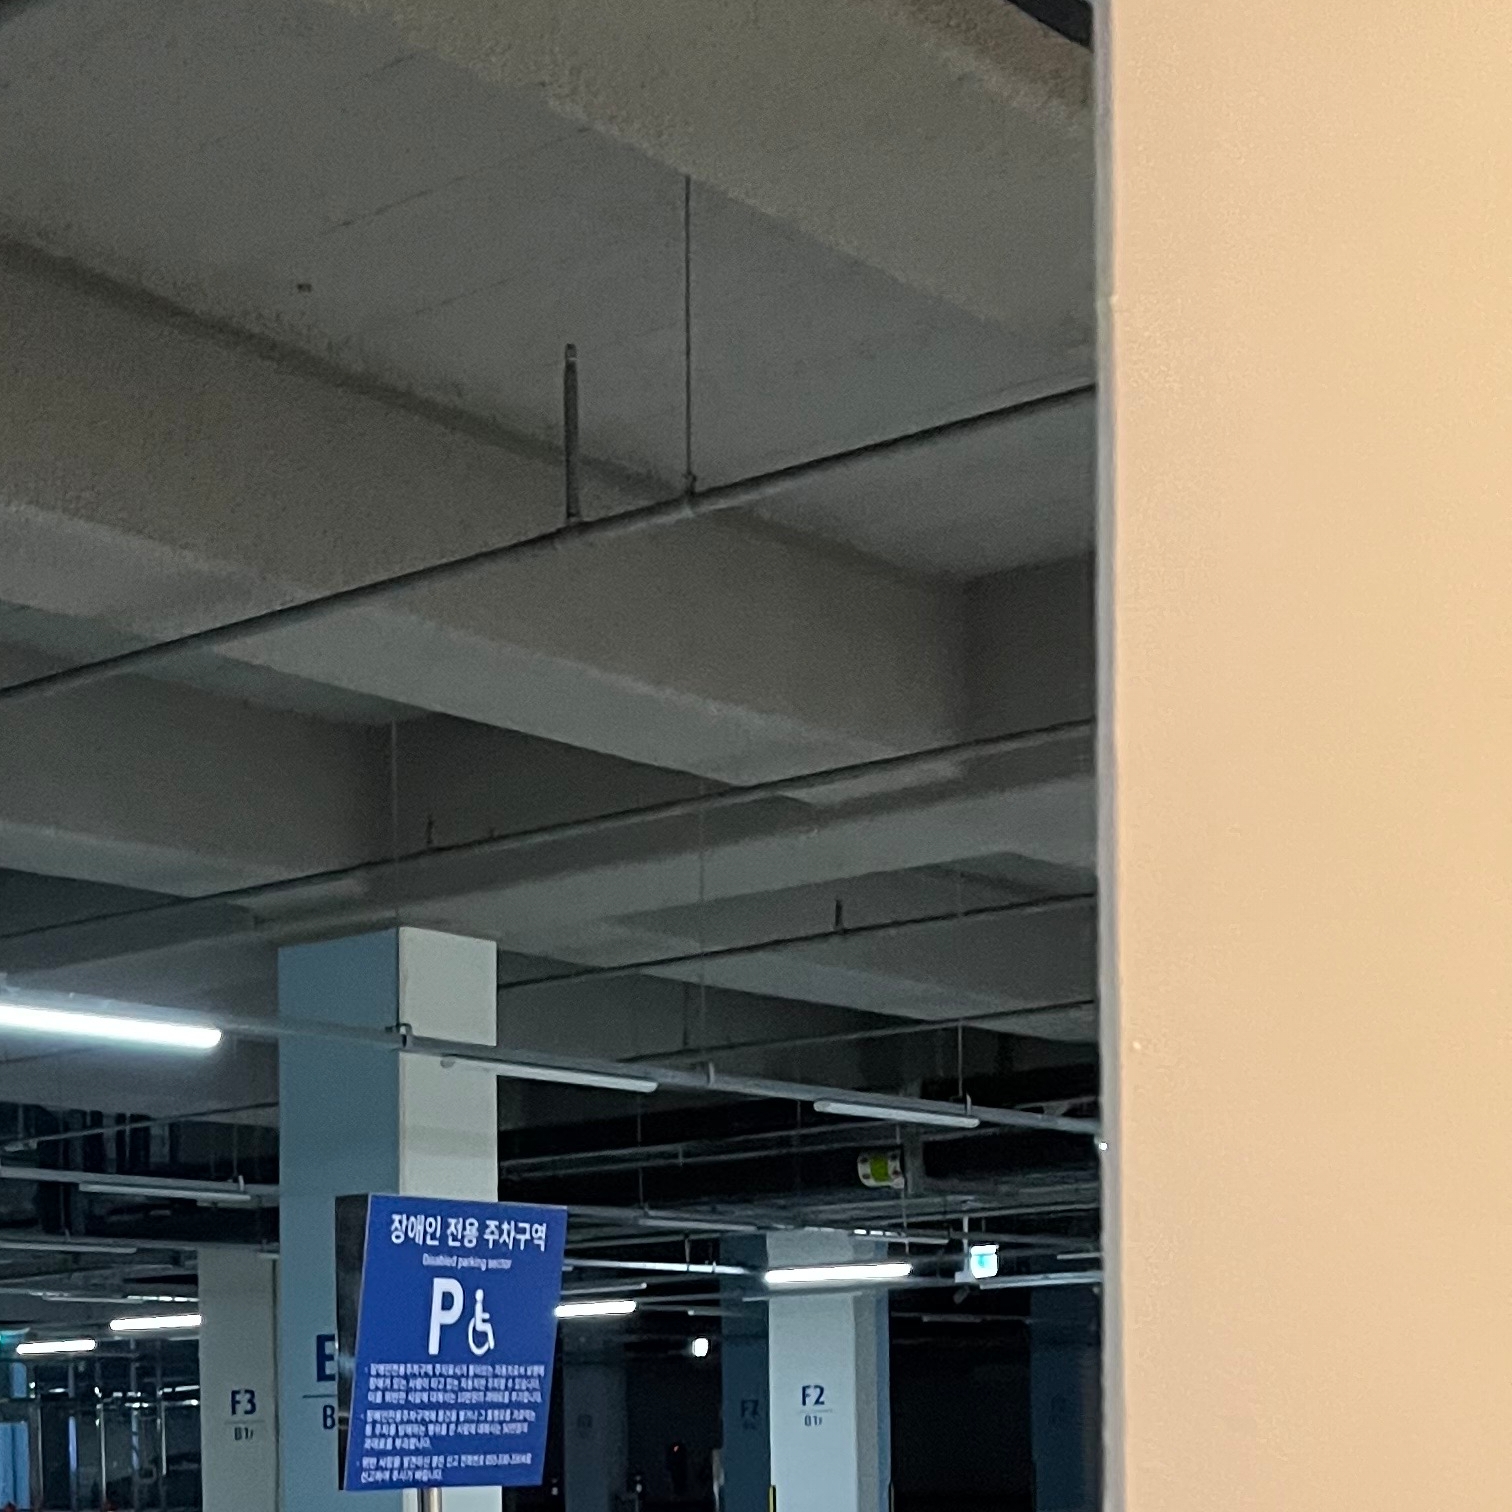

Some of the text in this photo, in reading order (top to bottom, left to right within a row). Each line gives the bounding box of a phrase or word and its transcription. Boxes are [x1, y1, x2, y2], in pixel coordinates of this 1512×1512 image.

[390, 1214, 547, 1251] 장애인 전용 주차구역
[428, 1277, 464, 1355] P
[316, 1334, 336, 1382] E
[231, 1389, 257, 1415] F3
[801, 1384, 825, 1406] F2
